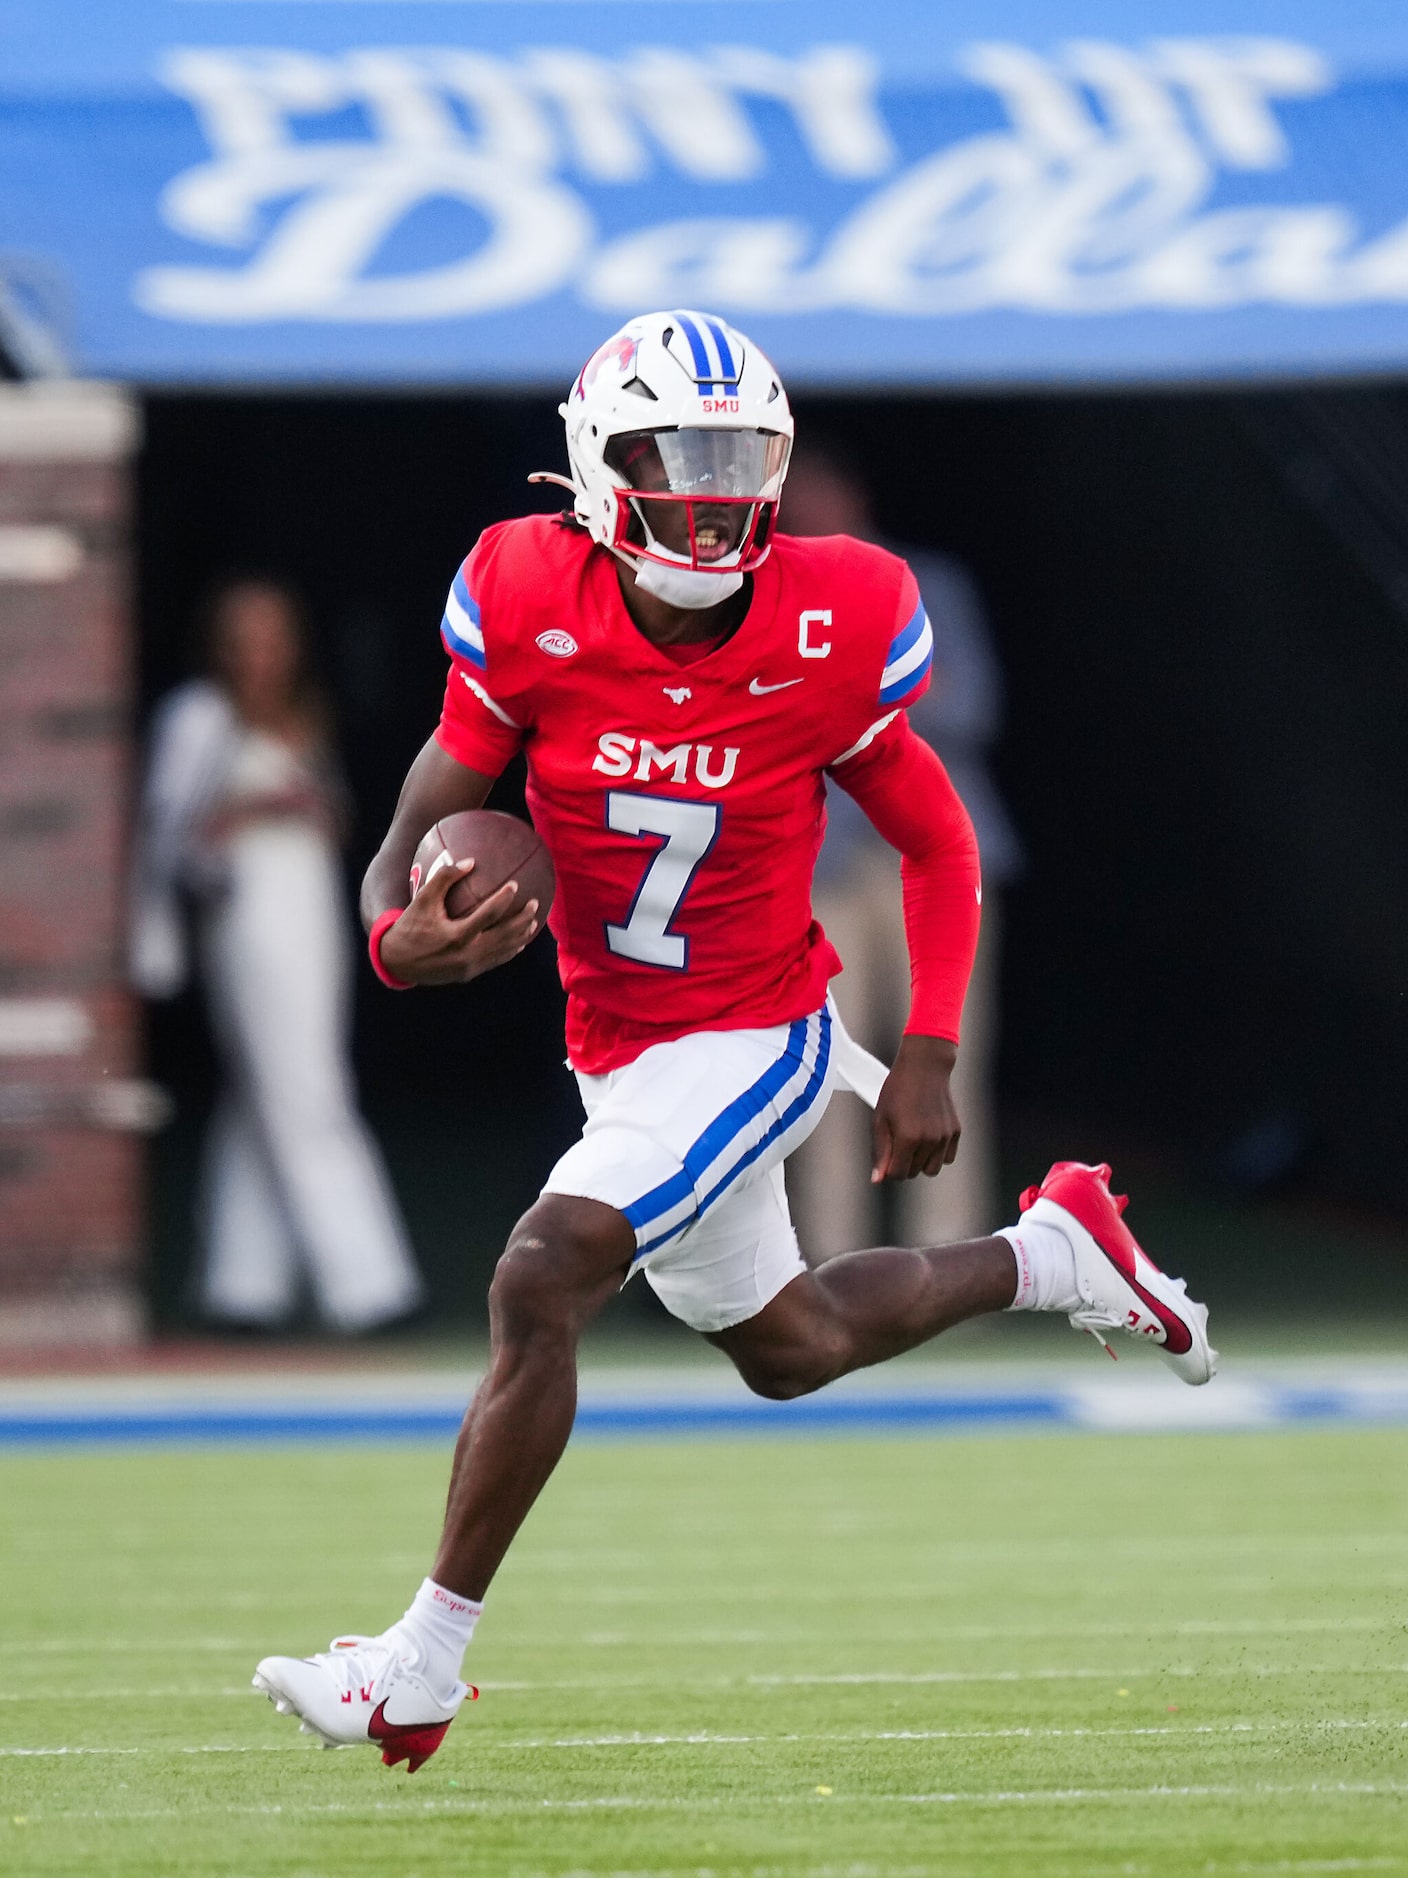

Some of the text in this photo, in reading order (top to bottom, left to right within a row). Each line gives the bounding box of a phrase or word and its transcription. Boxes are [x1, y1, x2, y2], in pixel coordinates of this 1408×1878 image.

[703, 400, 740, 413] SMU
[543, 638, 570, 650] ACC
[798, 610, 833, 658] C
[592, 732, 741, 788] SMU
[603, 790, 723, 972] 7
